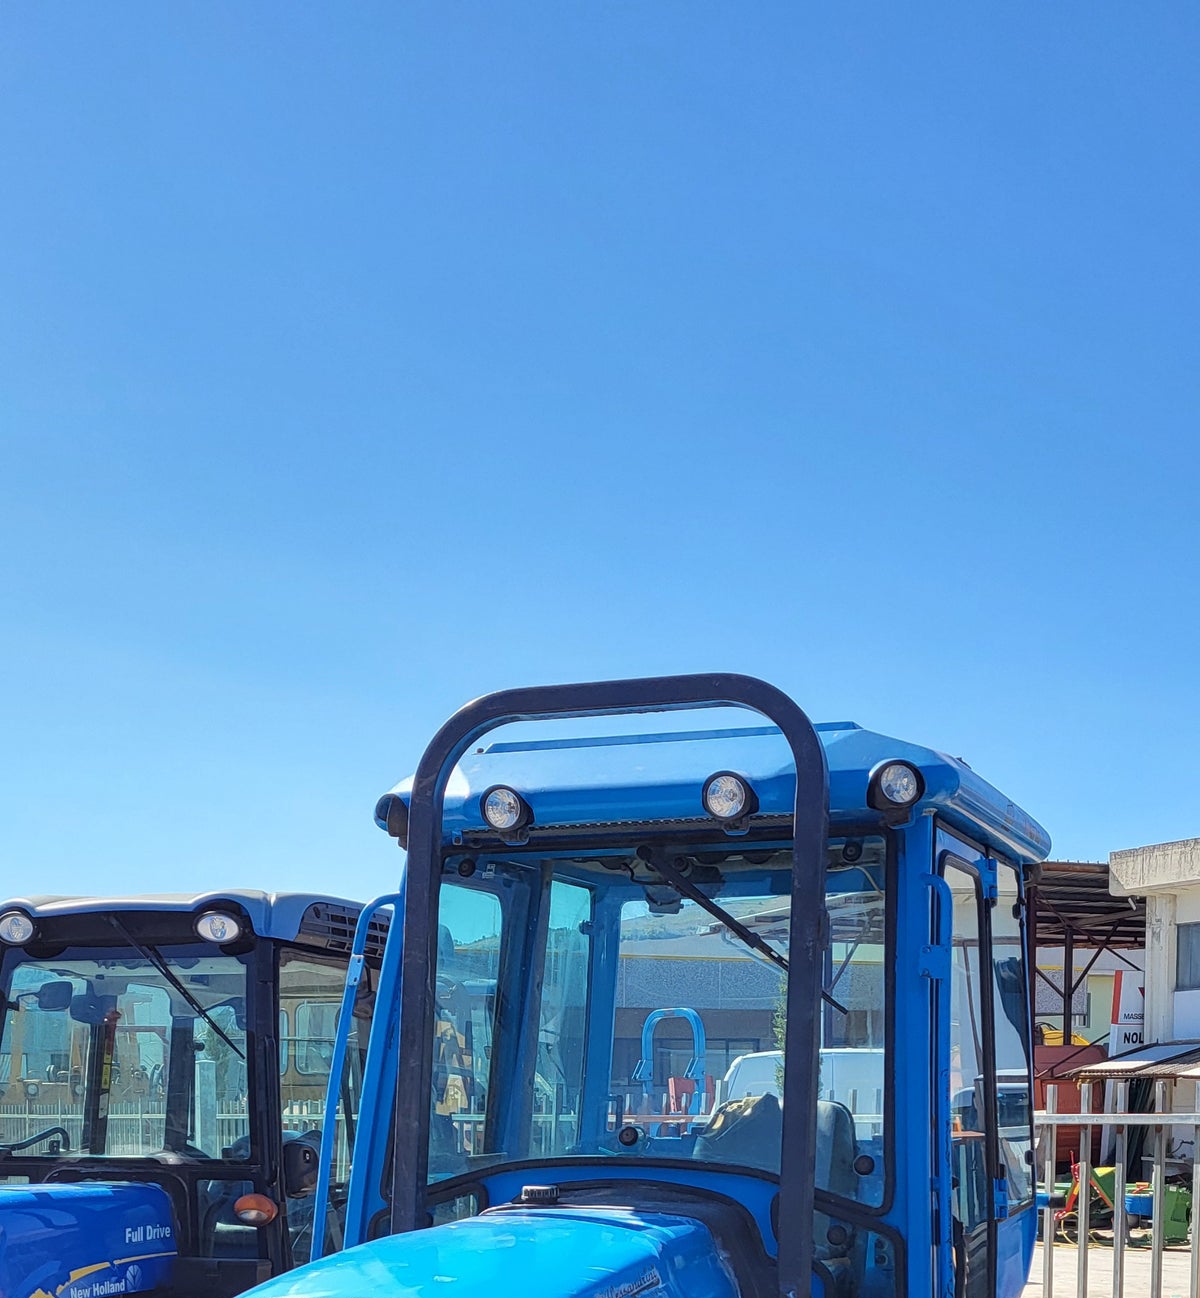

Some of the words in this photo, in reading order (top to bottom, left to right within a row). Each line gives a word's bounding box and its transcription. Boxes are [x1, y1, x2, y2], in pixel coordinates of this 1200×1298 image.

[125, 1226, 144, 1244] Full
[146, 1223, 171, 1241] Drive
[92, 1278, 126, 1297] Holland
